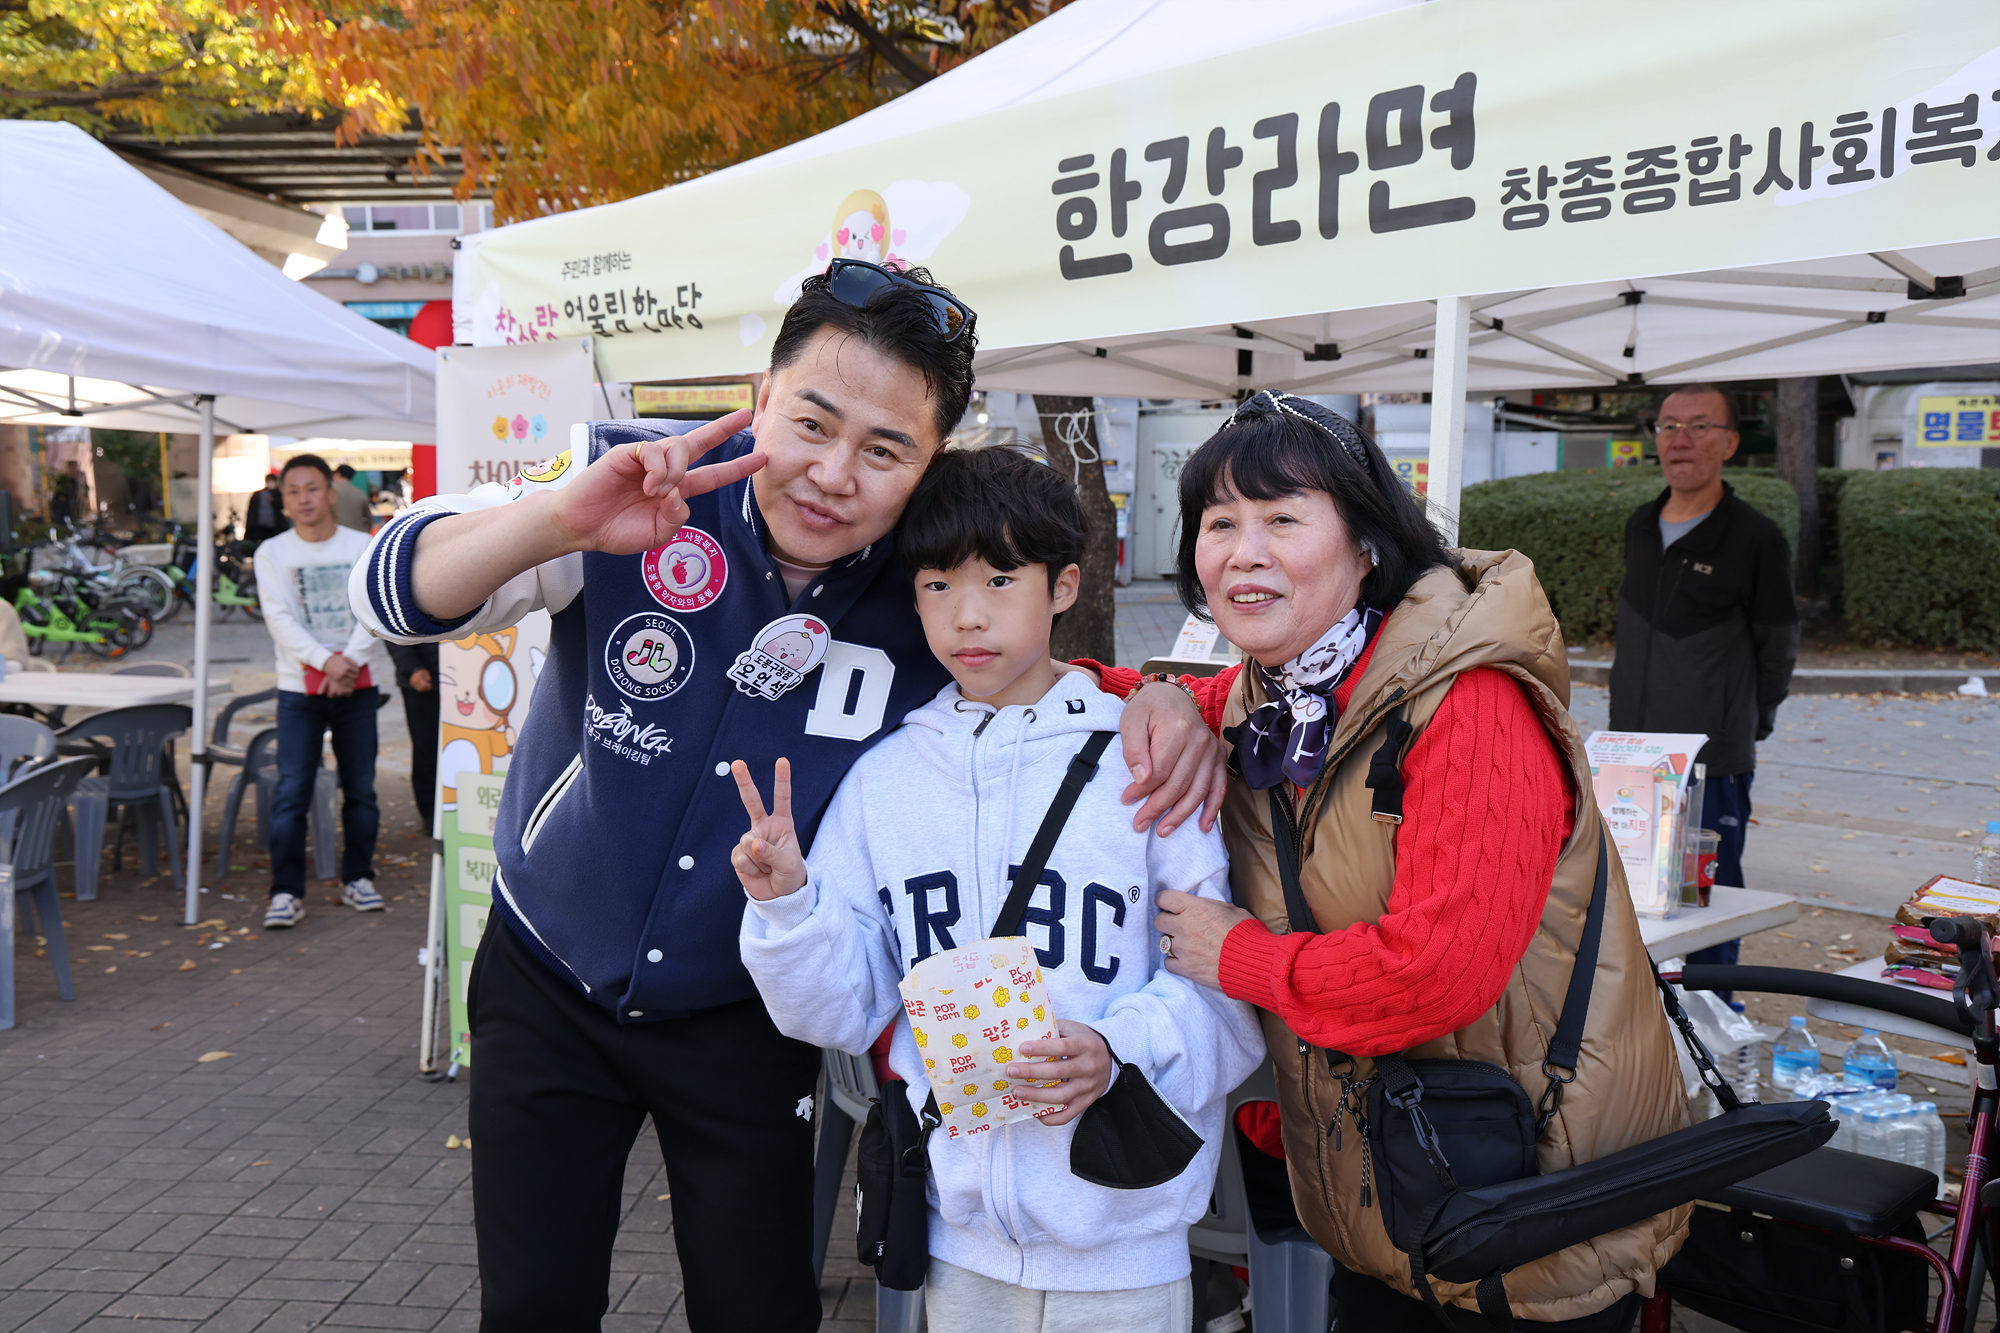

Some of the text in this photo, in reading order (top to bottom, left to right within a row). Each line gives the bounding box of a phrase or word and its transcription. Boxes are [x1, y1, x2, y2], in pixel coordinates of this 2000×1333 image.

[1051, 71, 2000, 280] 한강라면 창종종합사회복
[593, 250, 632, 275] 함께하는
[645, 618, 677, 637] SEOUL
[610, 658, 677, 696] DOBONG SOCKS
[753, 654, 794, 681] 도봉구청장
[804, 639, 896, 741] D
[601, 737, 652, 766] 브레이킹팀
[936, 1011, 960, 1022] corn
[982, 1019, 1011, 1042] 팝콘
[952, 1062, 977, 1074] corn
